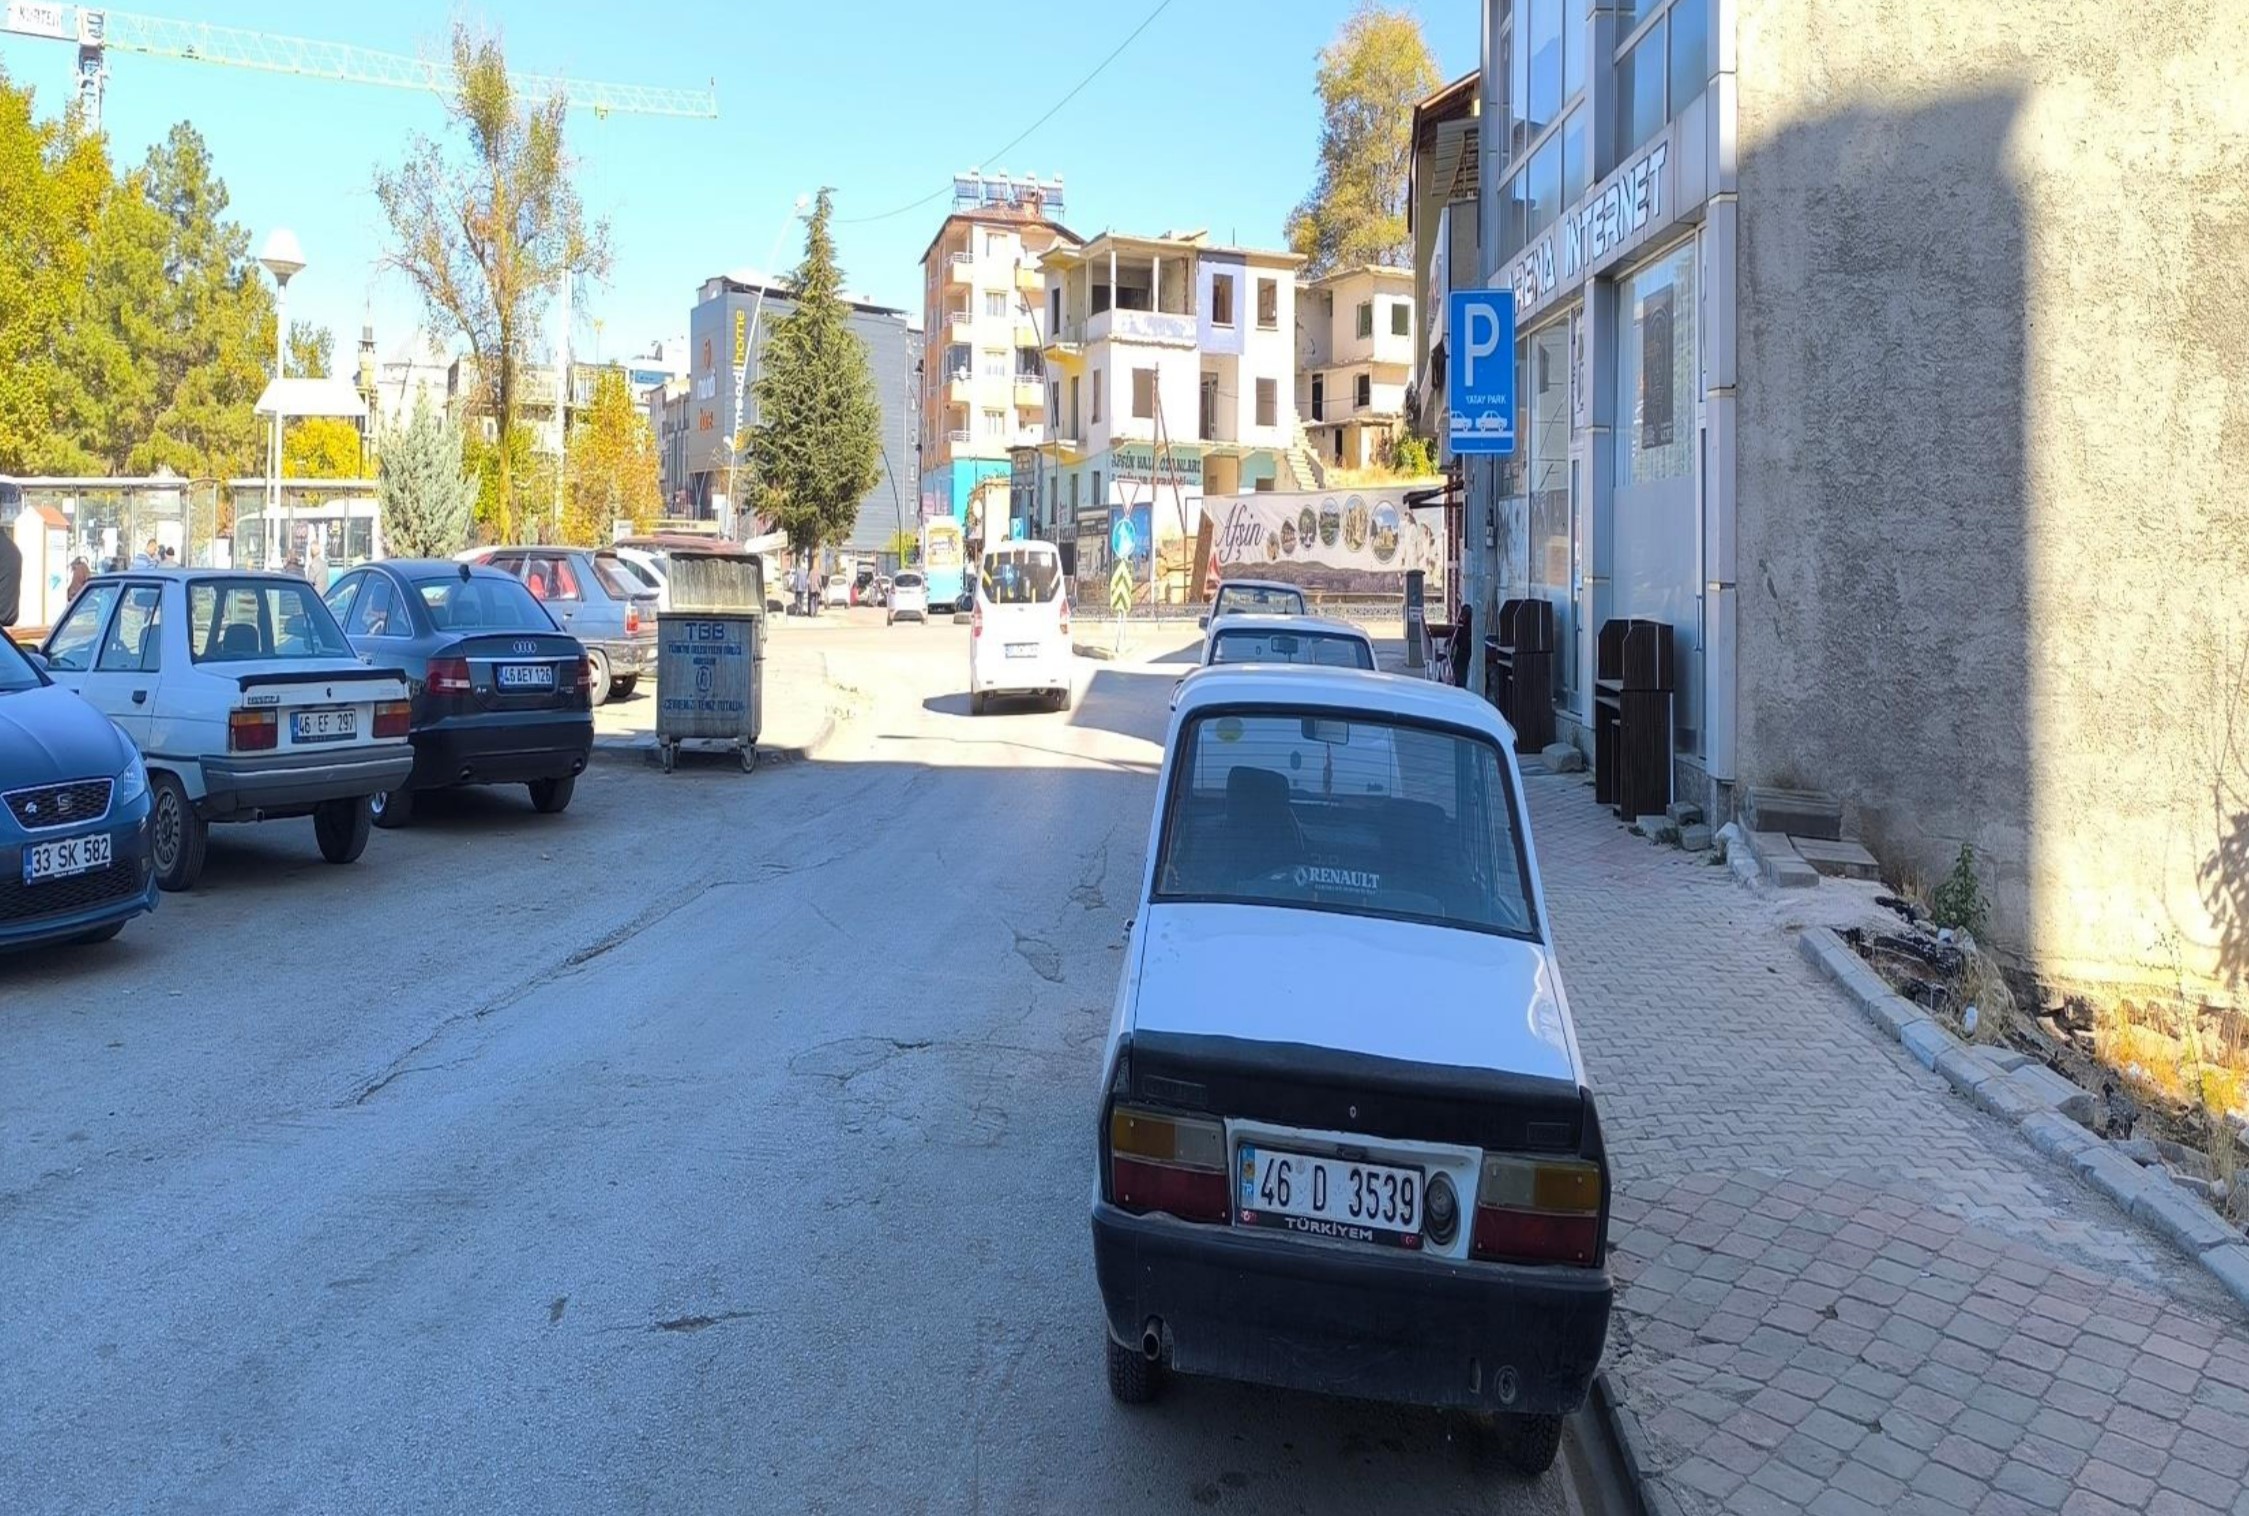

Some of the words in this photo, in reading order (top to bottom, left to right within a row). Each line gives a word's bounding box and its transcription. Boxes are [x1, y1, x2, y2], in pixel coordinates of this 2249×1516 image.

[733, 309, 745, 362] home
[1464, 303, 1500, 387] P
[1487, 395, 1506, 404] PARK
[1215, 503, 1265, 563] Afşin
[685, 622, 725, 640] TBB
[504, 668, 516, 682] 46
[536, 667, 551, 681] 126
[299, 715, 311, 734] 46
[318, 714, 329, 733] EF
[337, 713, 354, 731] 297
[33, 848, 51, 873] 33
[57, 842, 78, 868] SK
[83, 837, 110, 863] 582
[1309, 866, 1380, 889] RENAULT
[1261, 1158, 1292, 1207] 46
[1313, 1164, 1327, 1211] D
[1349, 1168, 1415, 1226] 3539
[1285, 1217, 1373, 1242] TÜRKİYEM
